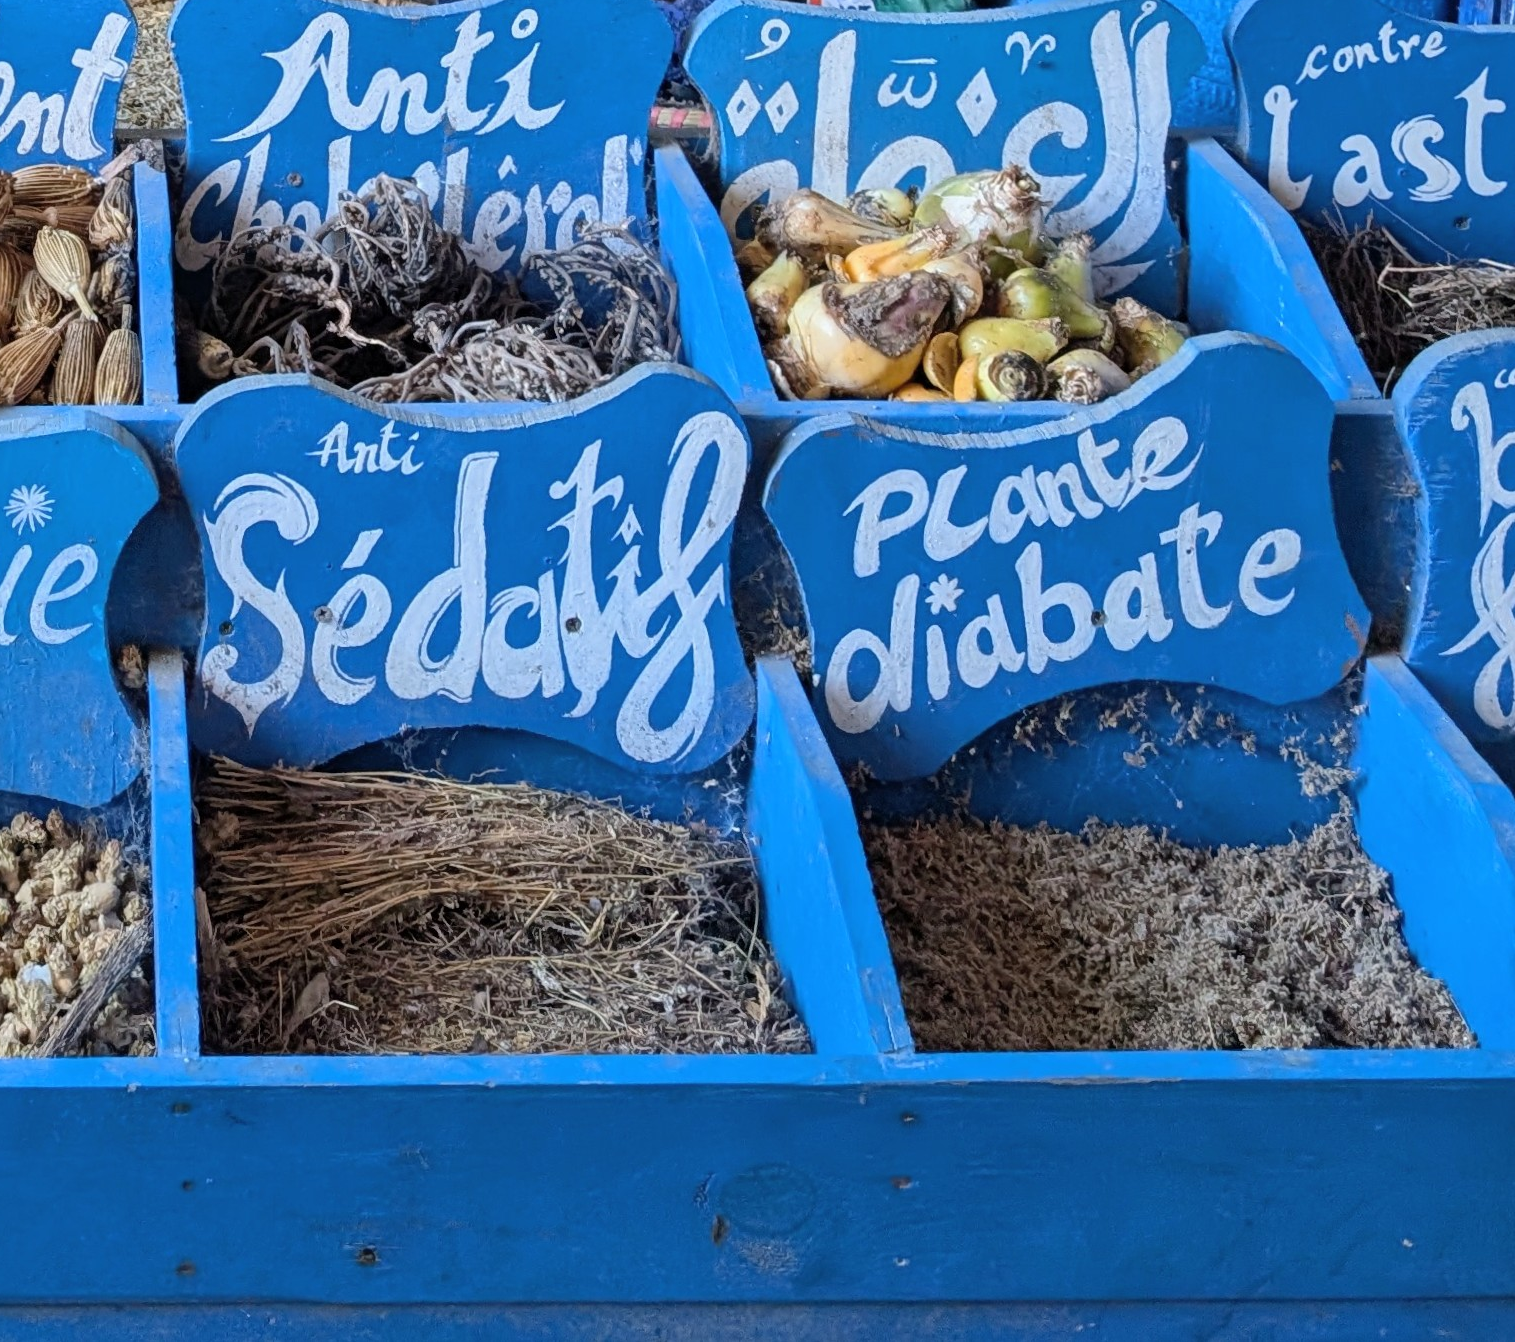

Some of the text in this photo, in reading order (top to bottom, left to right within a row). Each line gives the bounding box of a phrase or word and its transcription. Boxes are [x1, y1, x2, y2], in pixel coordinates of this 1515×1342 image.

[211, 9, 566, 142] Anti
[1296, 20, 1447, 85] contre
[305, 420, 423, 474] Anti
